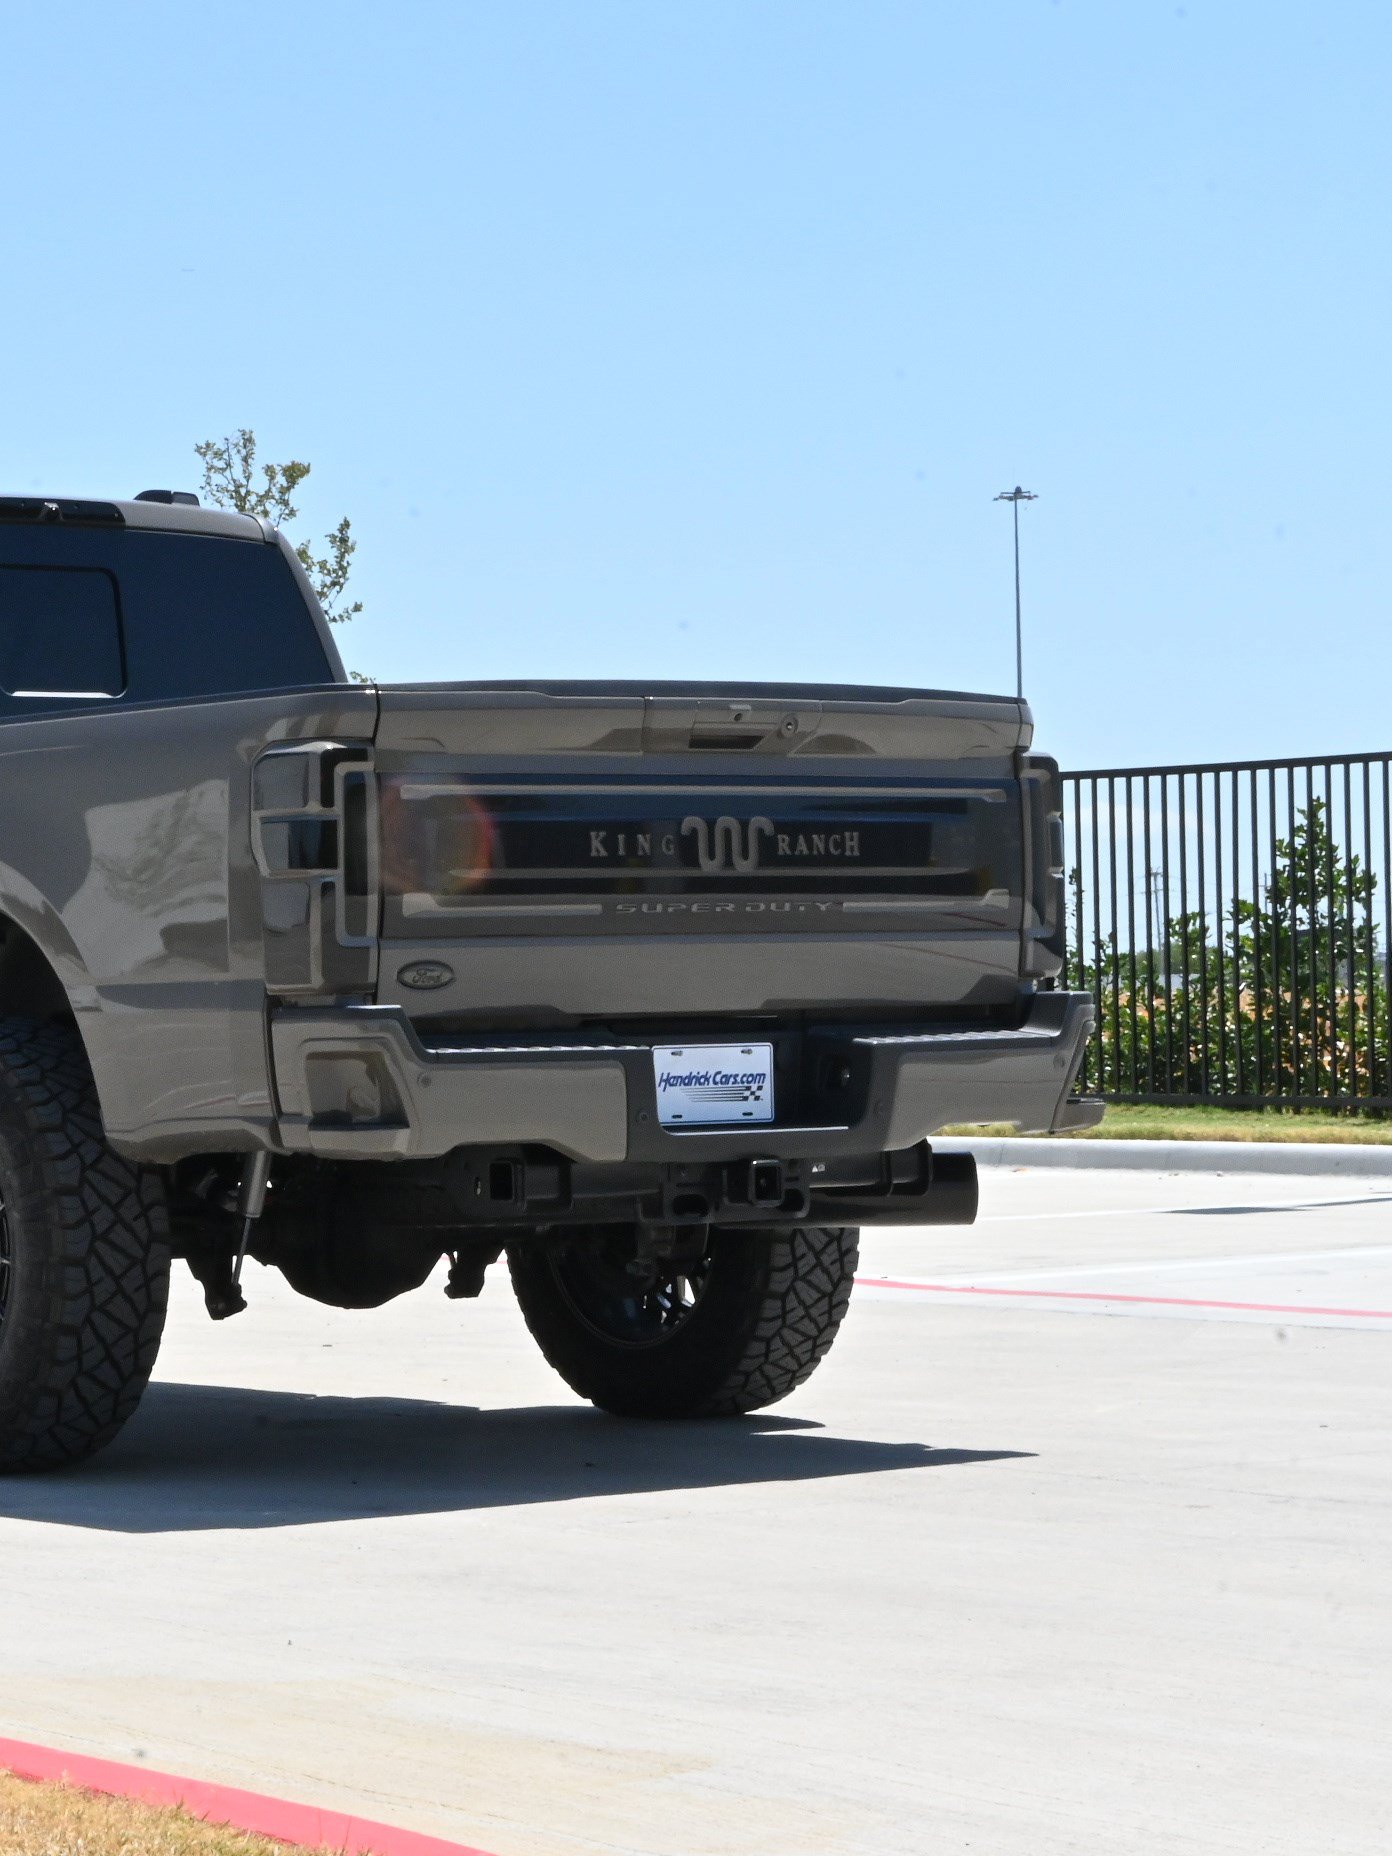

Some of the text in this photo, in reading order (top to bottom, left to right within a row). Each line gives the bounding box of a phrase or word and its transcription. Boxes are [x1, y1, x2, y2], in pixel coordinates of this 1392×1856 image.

[590, 831, 860, 856] KING RANCH
[616, 902, 833, 913] SUPER DUTY
